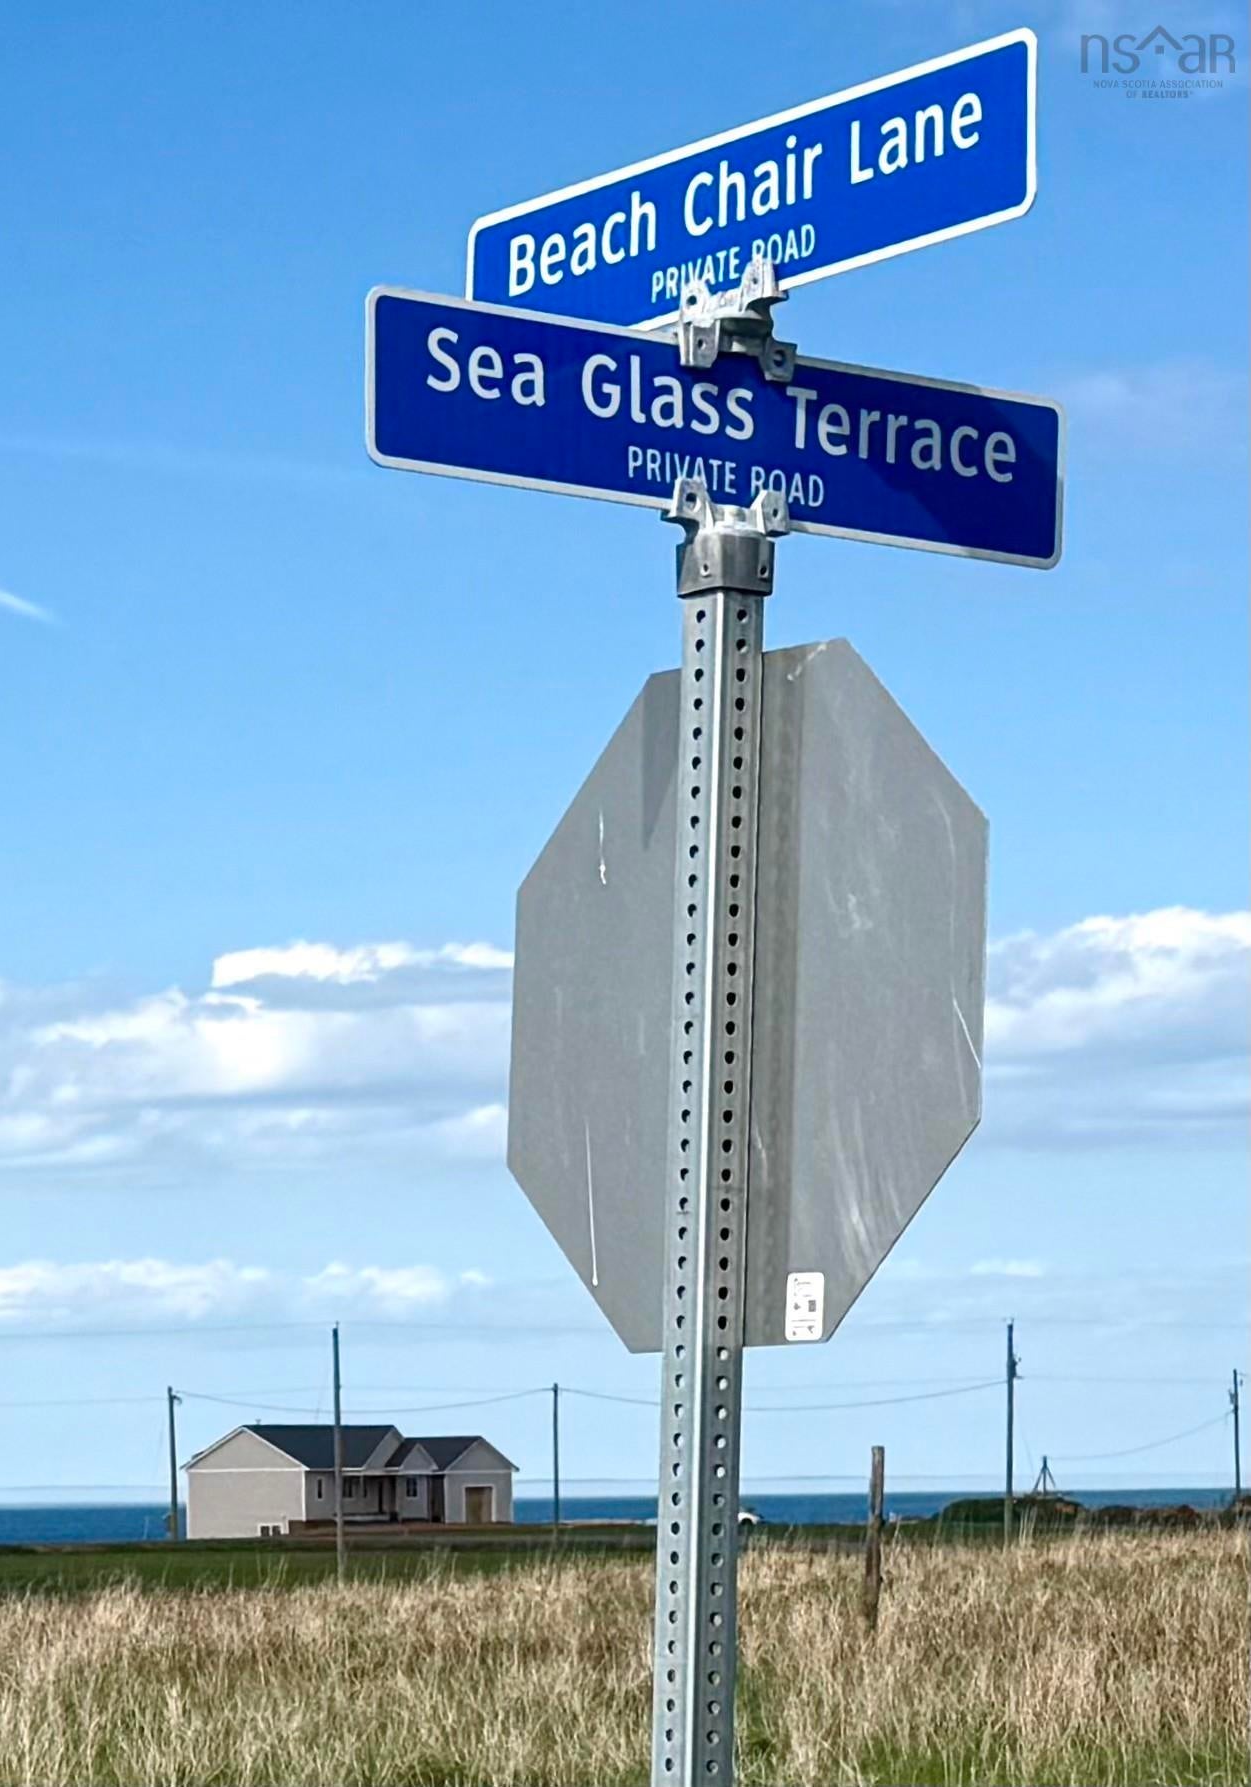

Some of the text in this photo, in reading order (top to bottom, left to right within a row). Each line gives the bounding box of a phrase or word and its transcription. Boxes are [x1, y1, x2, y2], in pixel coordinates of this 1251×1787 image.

[508, 92, 983, 297] Beach Chair Lane
[651, 246, 741, 303] PRIVATE
[426, 327, 1017, 483] Sea Glass Terrace
[628, 446, 825, 507] PRIVATE ROAD
